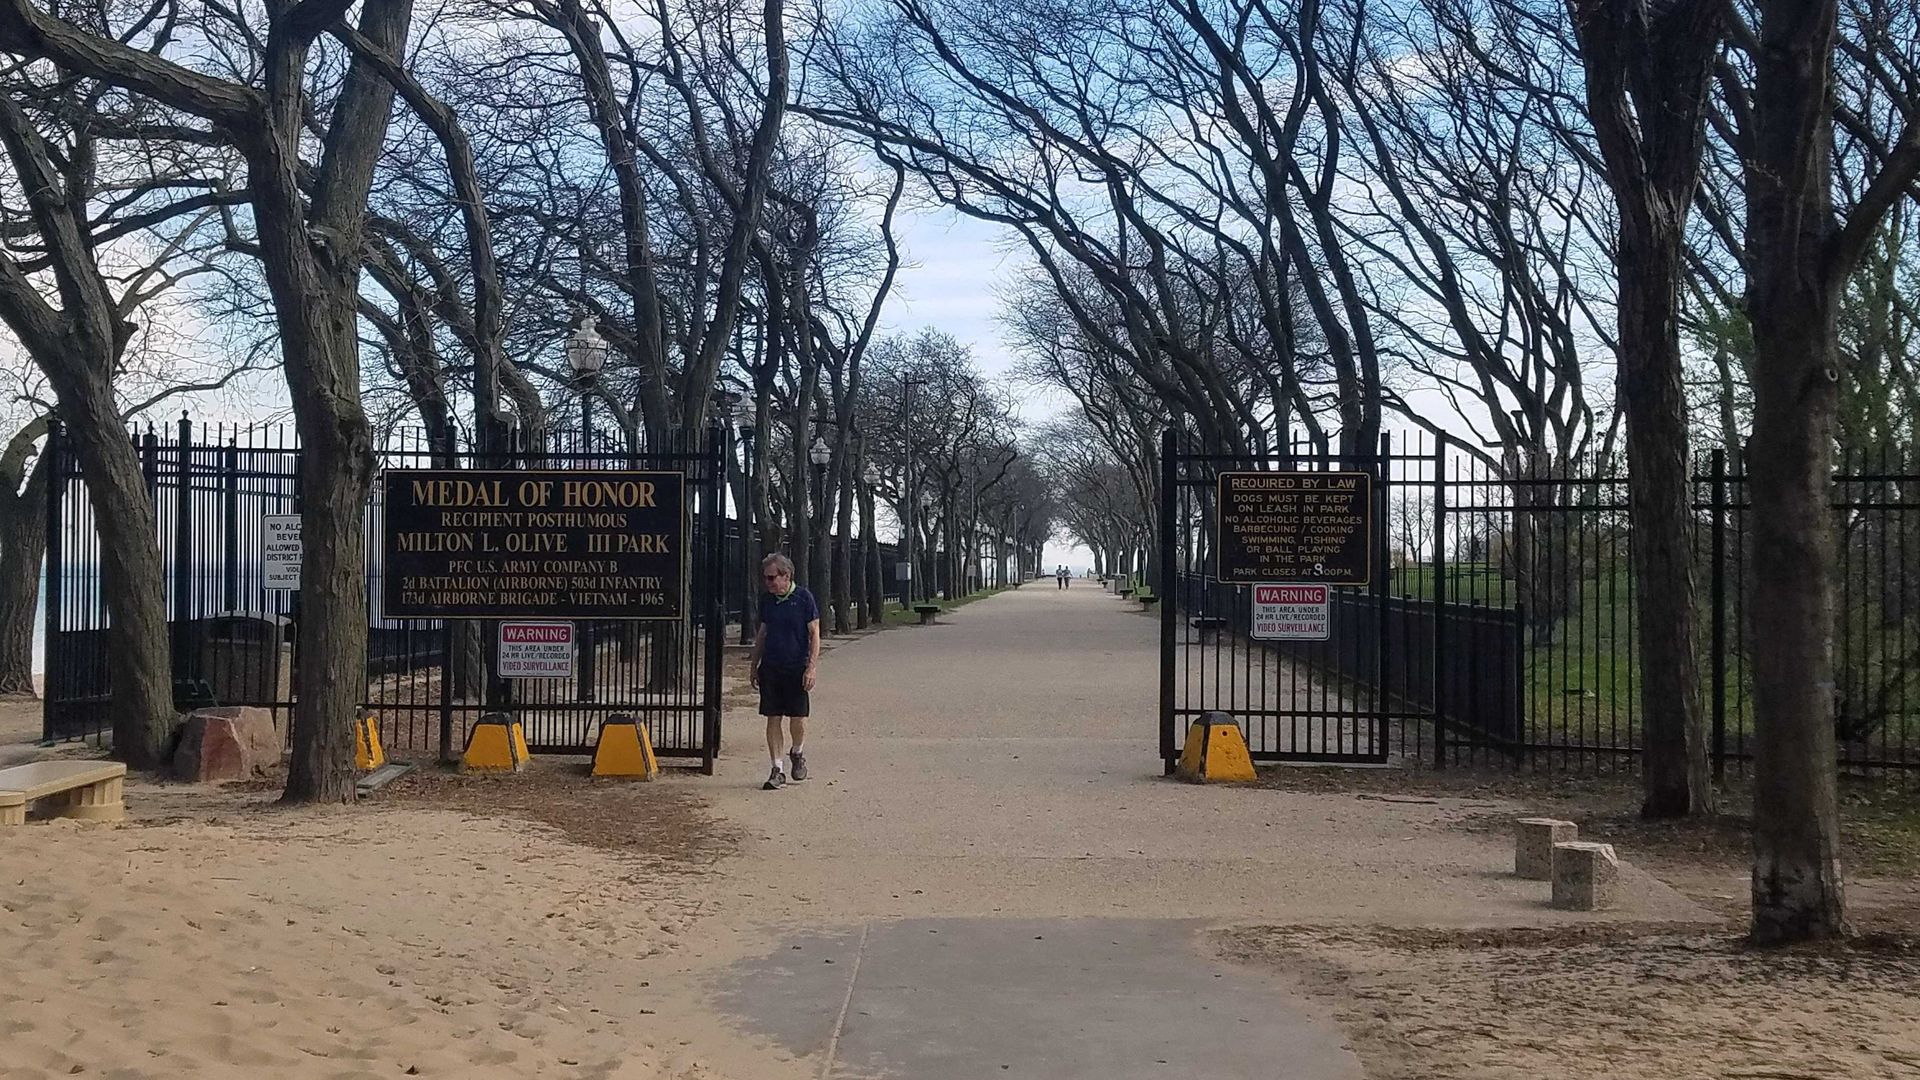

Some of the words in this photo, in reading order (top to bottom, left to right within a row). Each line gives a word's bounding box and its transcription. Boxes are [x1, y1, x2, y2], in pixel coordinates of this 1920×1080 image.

[1231, 478, 1295, 489] REQUIRED
[1302, 478, 1320, 488] BY
[1327, 479, 1356, 489] LAW
[412, 480, 509, 508] MEDAL
[518, 480, 554, 507] OF
[562, 481, 657, 508] HONOR
[1233, 494, 1263, 502] DOGS
[1268, 494, 1299, 502] MUST
[1305, 495, 1320, 503] BE
[1325, 495, 1354, 503] KEPT
[1238, 505, 1253, 513] ON
[1260, 505, 1297, 513] LEASH
[1303, 505, 1314, 513] IN
[1320, 505, 1350, 513] PARK
[441, 512, 523, 528] RECIPIENT
[527, 512, 628, 529] POSTHUMOUS
[1225, 516, 1239, 524] NO
[1243, 516, 1299, 524] ALCOHOLIC
[1303, 516, 1363, 524] BEVERAGES
[270, 523, 282, 531] NO
[1233, 525, 1297, 533] BARBECUING
[1310, 525, 1354, 534] COOKING
[398, 532, 474, 553] MILTON
[481, 531, 499, 553] L.
[505, 533, 568, 553] OLIVE
[587, 534, 610, 553] III
[617, 534, 670, 554] PARK
[1303, 536, 1346, 544] FISHING
[1246, 545, 1260, 553] OR
[1265, 545, 1293, 553] BALL
[1298, 545, 1341, 553] PLAYING
[266, 553, 298, 561] DISTRICT
[1259, 555, 1270, 563] IN
[1275, 555, 1295, 563] THE
[1300, 555, 1326, 563] PARK
[448, 560, 472, 574] PFC
[476, 560, 498, 574] U.S.
[501, 560, 540, 574] ARMY
[543, 561, 606, 574] COMPANY
[609, 561, 618, 574] B
[402, 577, 415, 590] 2d
[419, 577, 489, 590] BATTALION
[493, 577, 568, 592] (AIRBORNE)
[571, 577, 596, 590] 503d
[599, 577, 663, 590] INFANTRY
[401, 592, 425, 606] 173d
[429, 593, 496, 606] AIRBORNE
[500, 593, 557, 606] BRIGADE
[569, 593, 628, 606] VIETNAM
[640, 592, 664, 606] 1965
[1260, 589, 1322, 601] WARNING
[1257, 623, 1276, 632] VIDEO
[1278, 623, 1325, 632] SURVEILLANCE
[506, 628, 567, 640] WARNING
[503, 661, 520, 670] VIDEO
[522, 661, 569, 671] SURVEILLANCE
